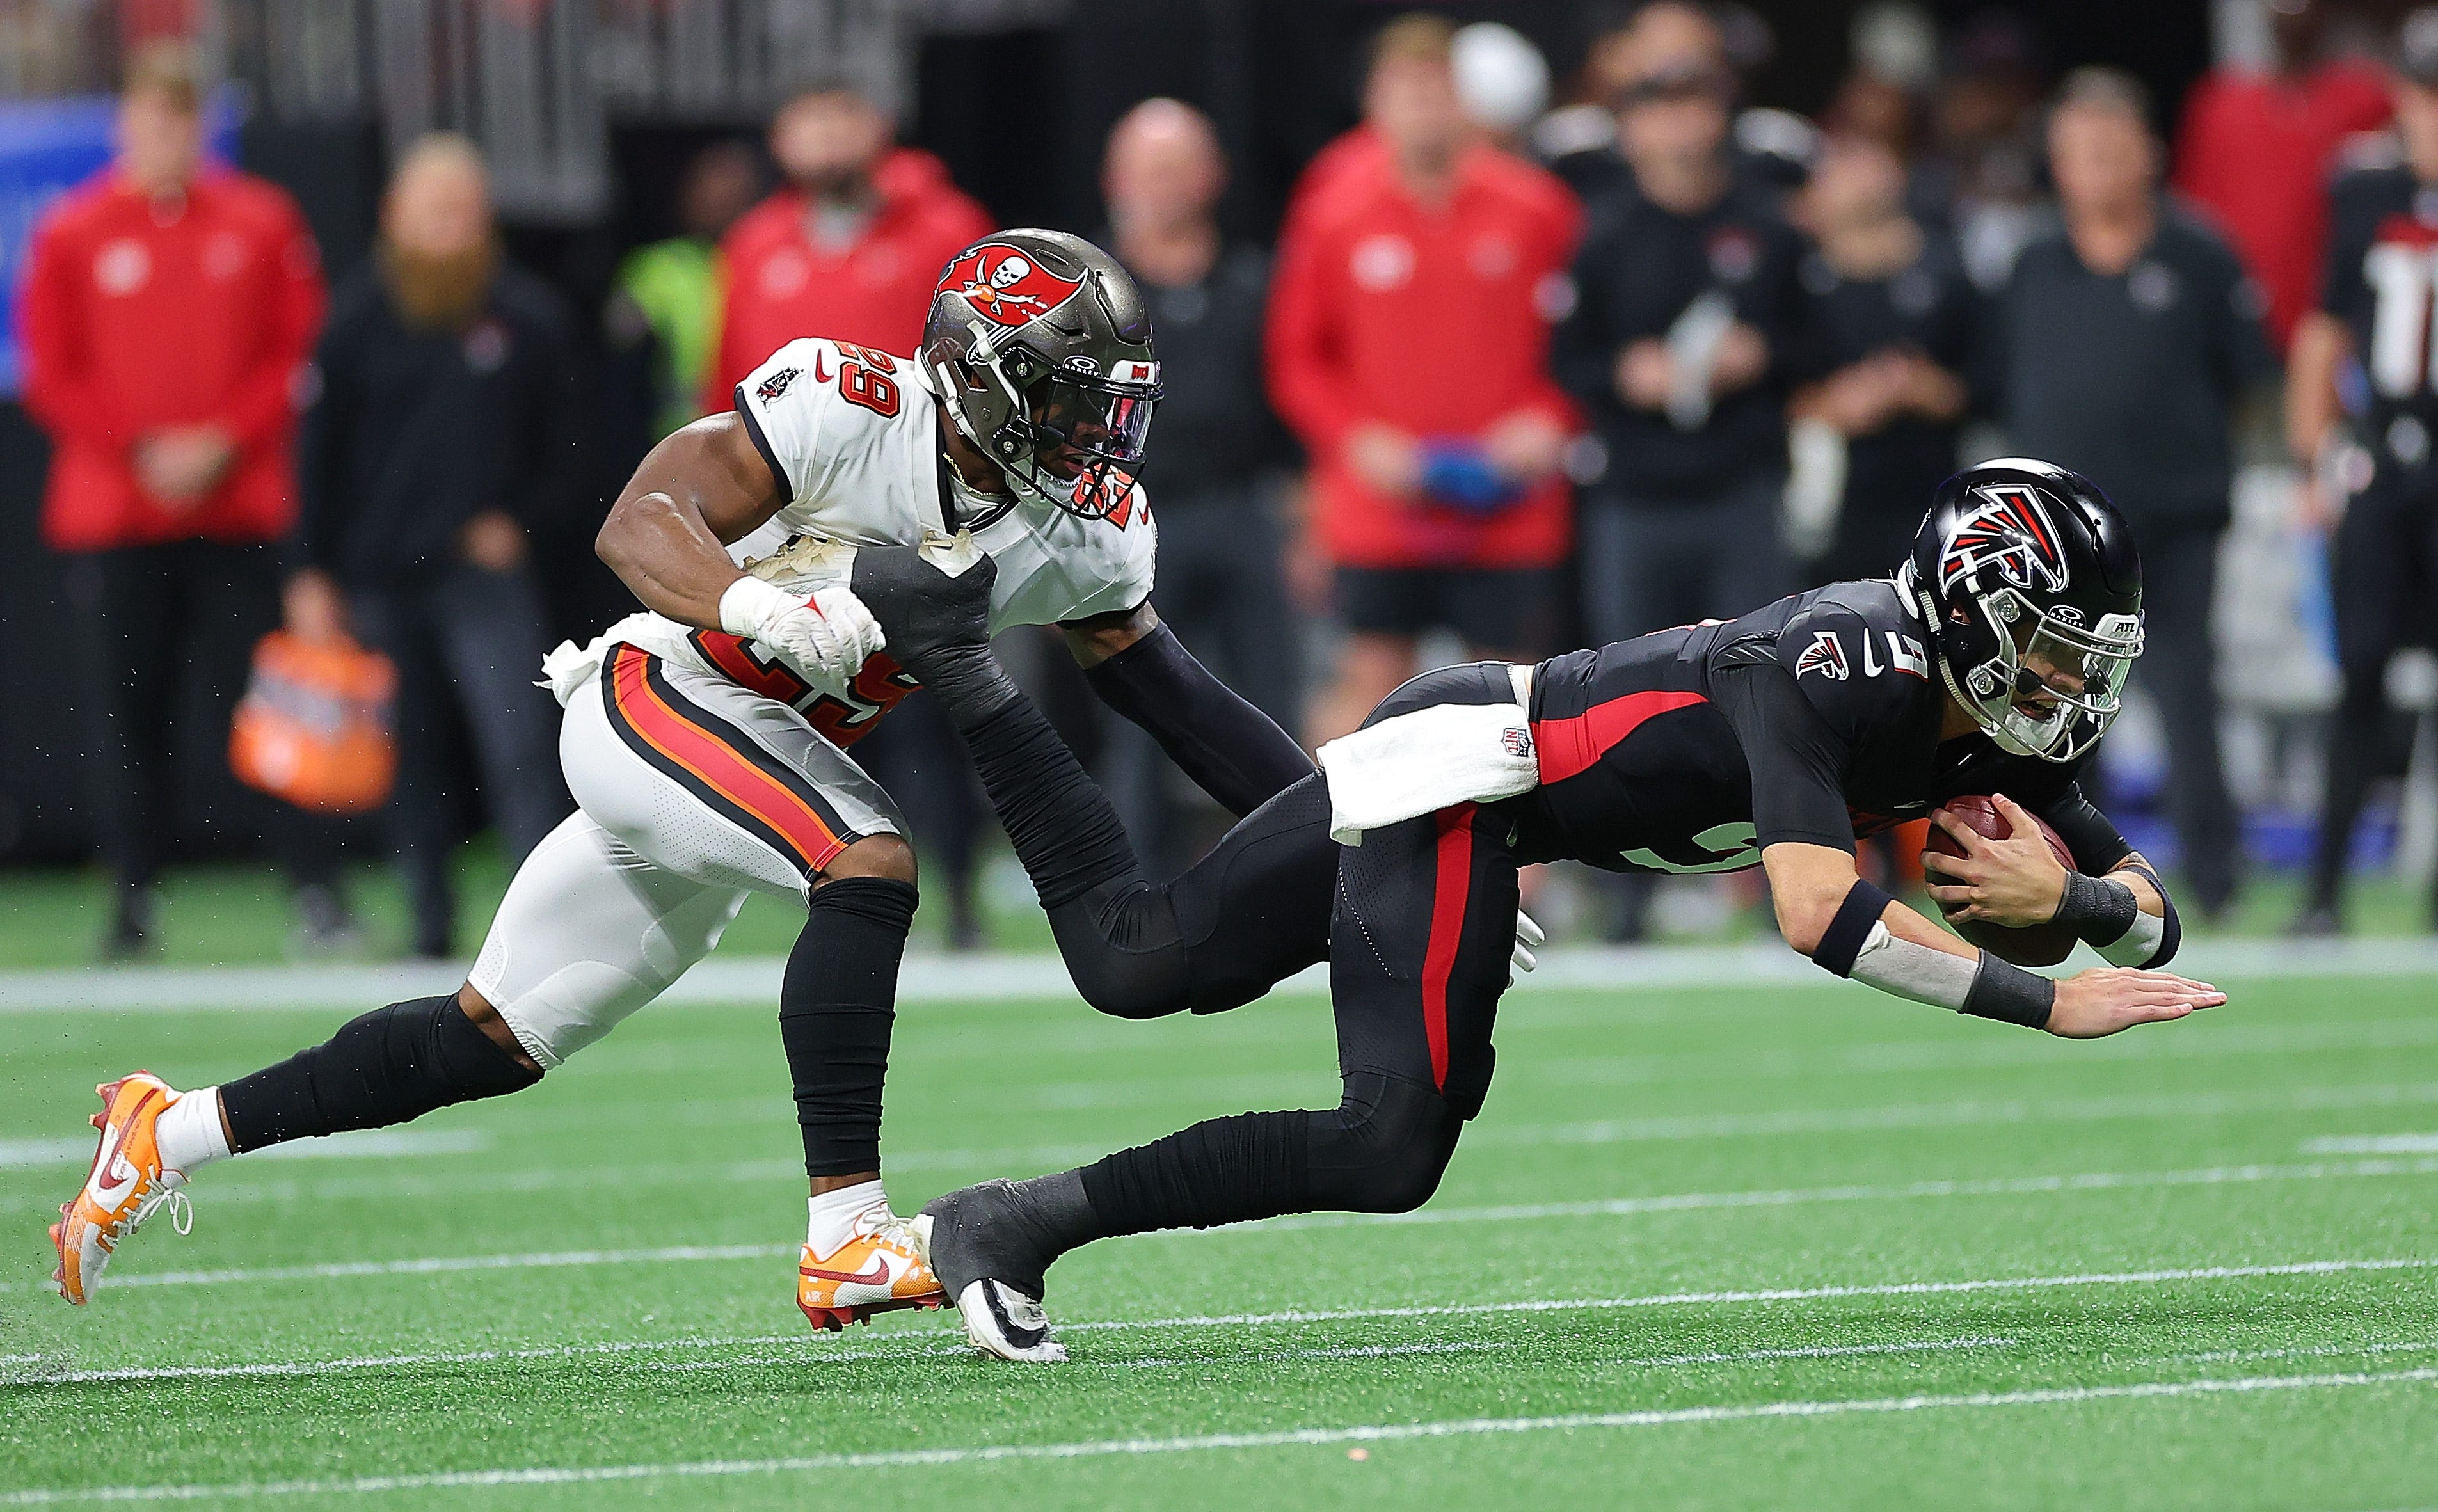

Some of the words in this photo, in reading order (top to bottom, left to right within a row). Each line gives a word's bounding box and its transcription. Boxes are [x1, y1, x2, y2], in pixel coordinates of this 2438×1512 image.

[2361, 239, 2438, 399] 1
[1064, 363, 1099, 377] OAKLEY
[833, 340, 900, 420] 29
[2050, 612, 2084, 628] OAKLEY
[2114, 621, 2135, 633] ATL
[1504, 730, 1519, 753] NFL
